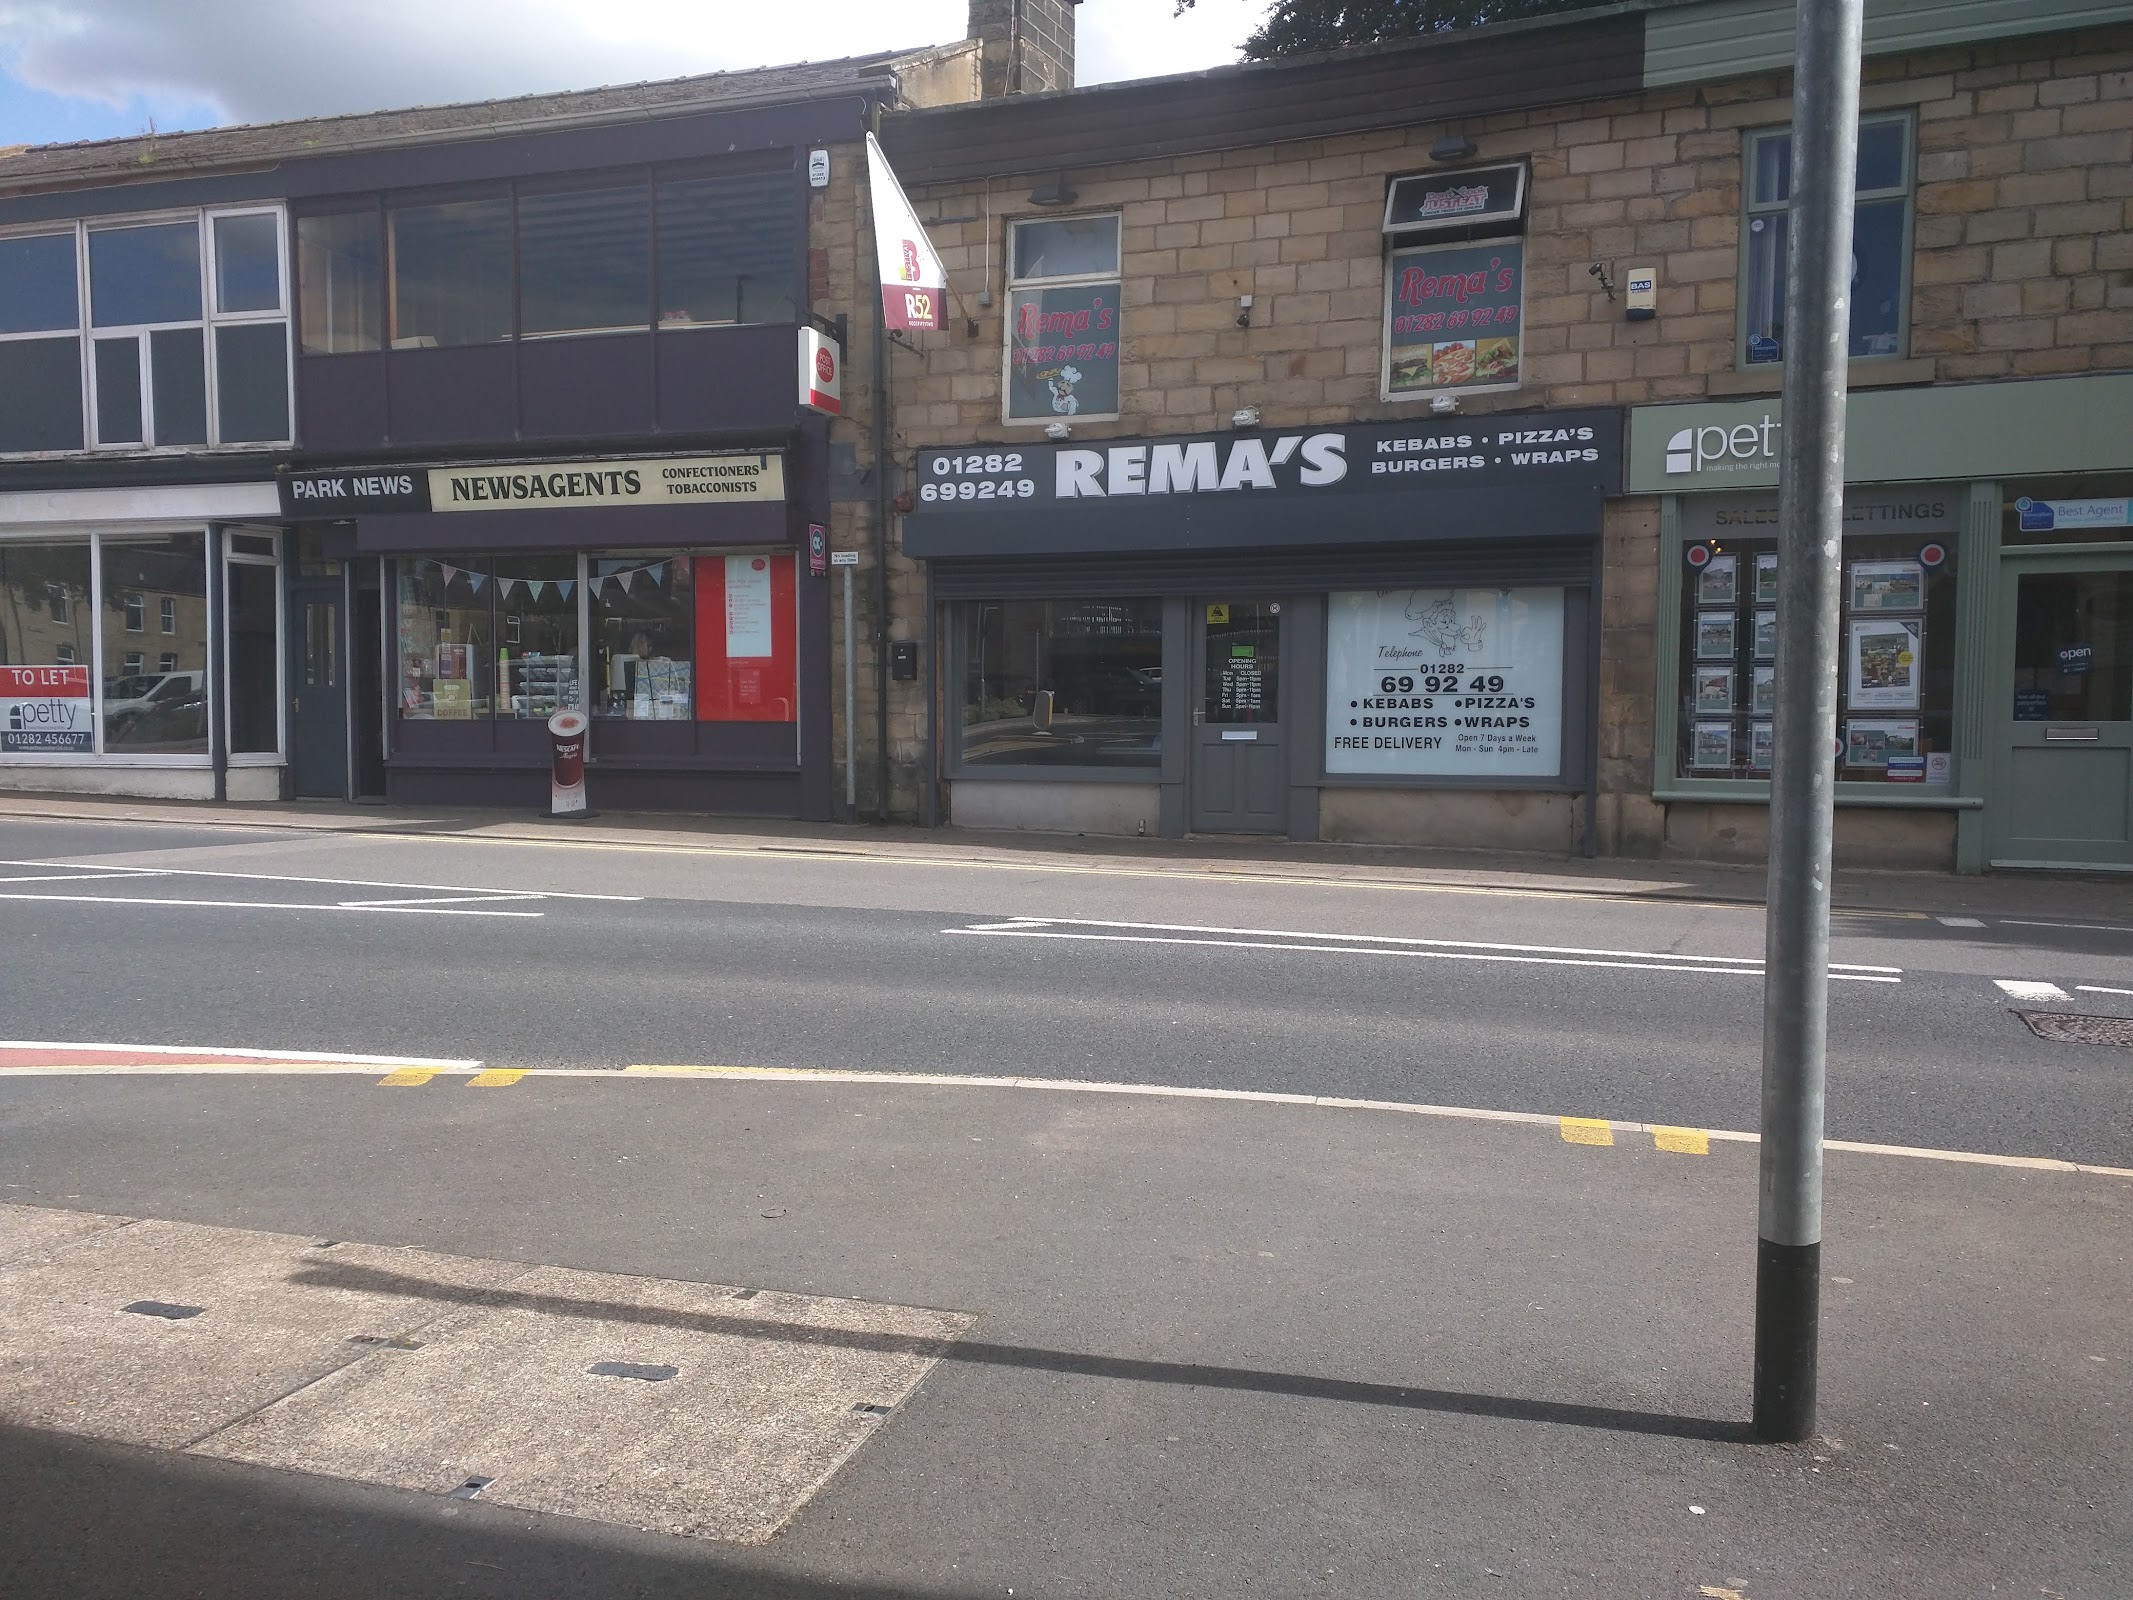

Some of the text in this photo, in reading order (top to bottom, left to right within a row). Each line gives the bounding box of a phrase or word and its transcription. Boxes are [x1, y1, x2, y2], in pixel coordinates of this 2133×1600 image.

[1399, 257, 1514, 307] Rema's
[1631, 281, 1651, 290] BAS
[905, 293, 932, 319] R52
[1017, 298, 1113, 340] Rema's
[1395, 305, 1518, 334] 01282 69 92 49
[819, 353, 831, 364] POST
[1013, 342, 1116, 365] 01282 69 92 49
[817, 362, 832, 376] OFFICE
[1376, 427, 1594, 453] KEBABS PIZZA'S
[1696, 414, 1782, 472] pet
[932, 453, 1023, 475] 01282
[1055, 433, 1348, 499] REMA'S
[1371, 448, 1599, 474] BURGERS WRAPS
[1706, 463, 1734, 472] making
[1735, 462, 1748, 470] the
[1749, 462, 1767, 470] right
[662, 464, 760, 479] CONFECTIONERS
[292, 475, 413, 498] PARK NEWS
[450, 469, 641, 501] NEWSAGENTS
[666, 481, 757, 495] TOBACCONISTS
[920, 479, 1035, 501] 699249
[2058, 505, 2124, 517] Best Agent
[1378, 646, 1423, 661] Telephone
[2060, 648, 2091, 660] open
[1420, 664, 1464, 674] 01282
[11, 669, 69, 685] TO LET
[1381, 675, 1504, 693] 69 92 49
[1363, 697, 1535, 709] KEBABS PIZZA'S
[22, 699, 76, 729] petty
[437, 709, 468, 717] COFFEE
[1363, 716, 1530, 728] BURGERS WRAPS
[8, 733, 85, 744] 01282 456677
[1334, 736, 1442, 749] FREE DELIVERY
[1458, 734, 1478, 743] Open
[1487, 734, 1506, 743] Days
[1515, 734, 1536, 742] Week
[1497, 745, 1515, 754] 4pm
[1522, 745, 1539, 753] Late
